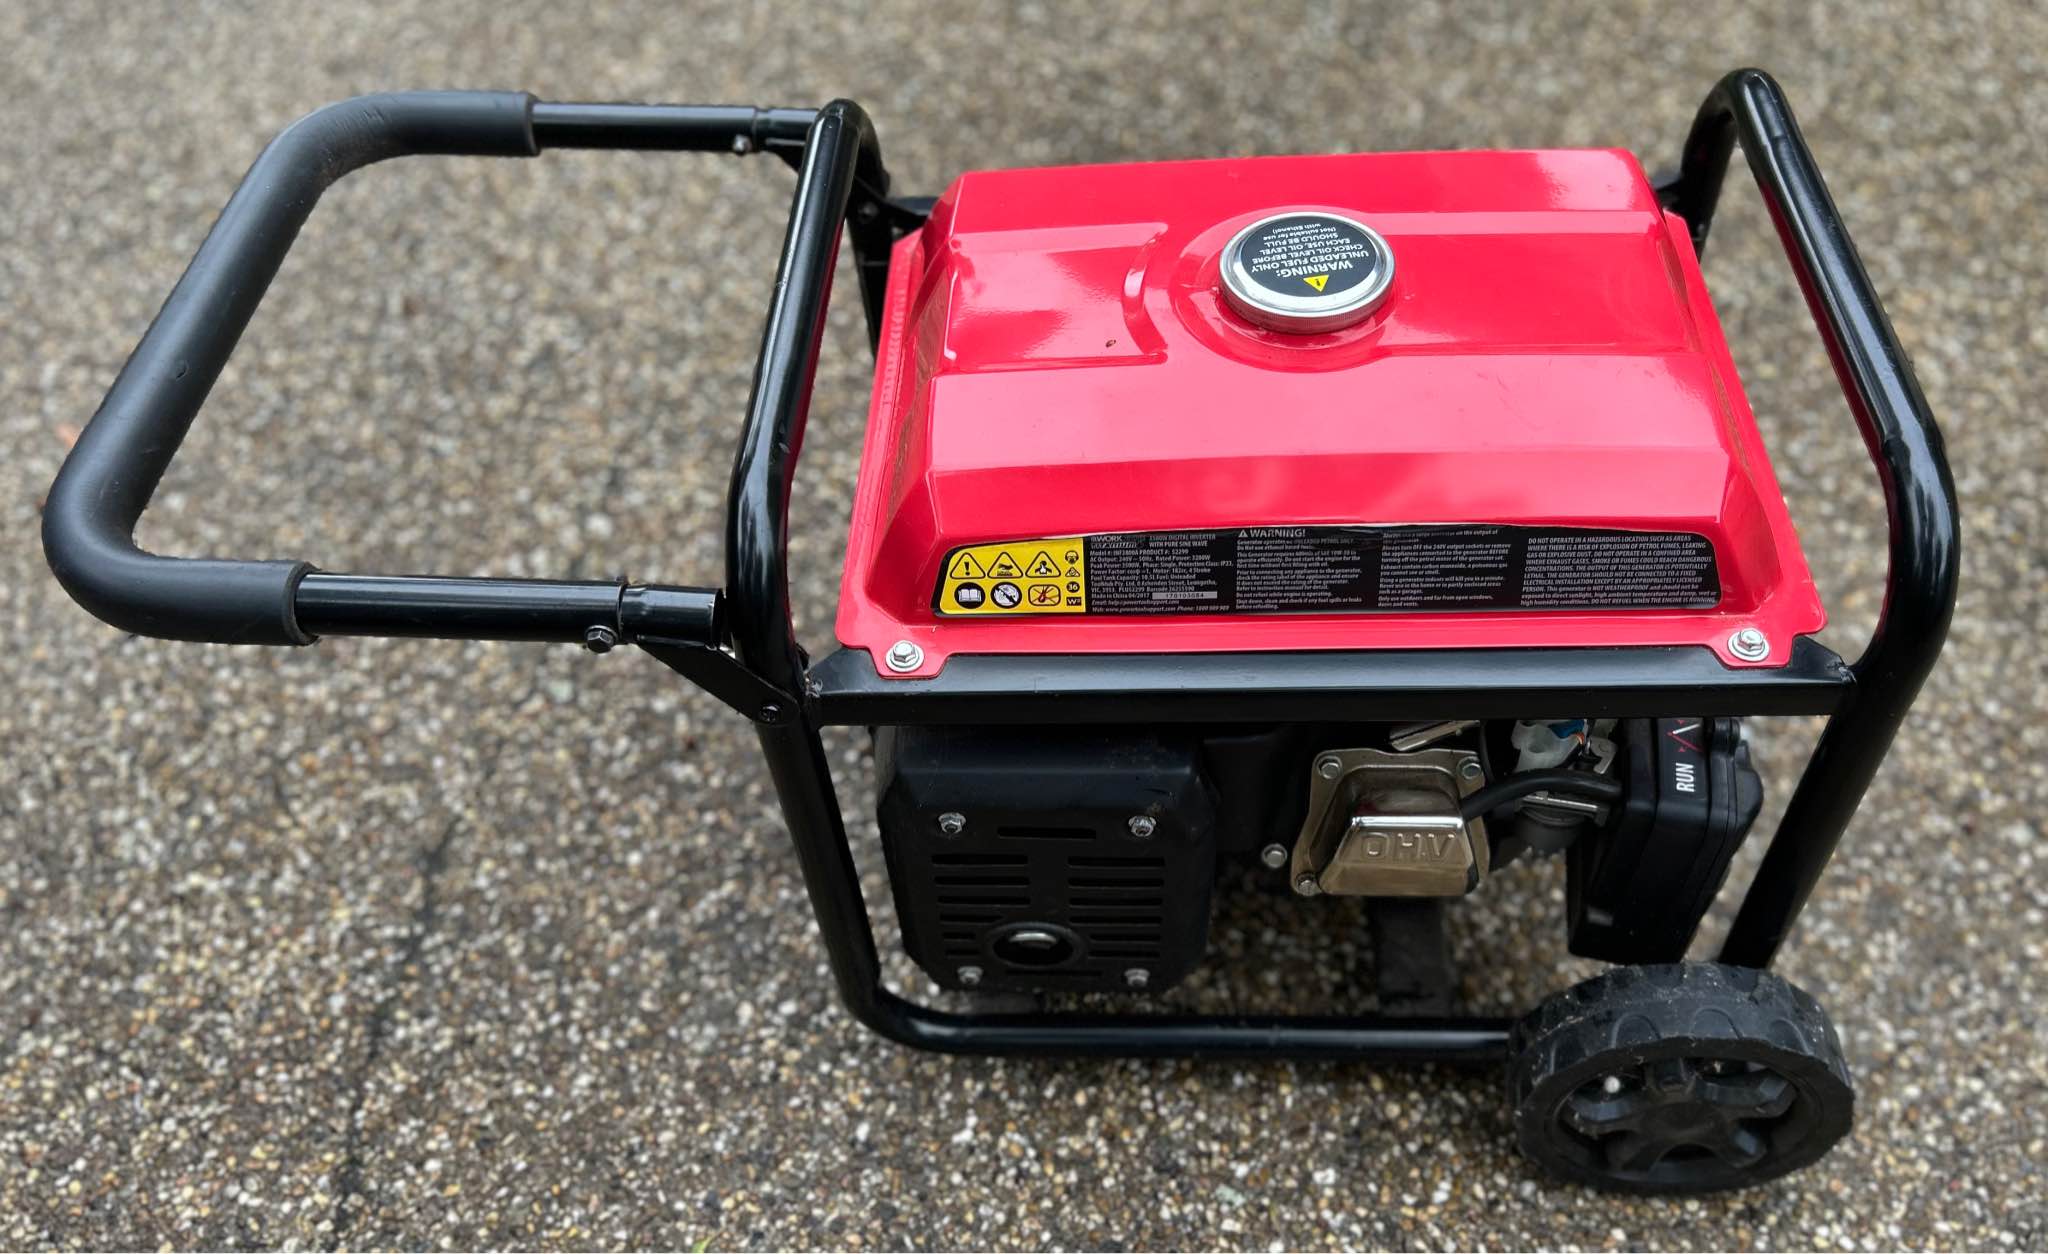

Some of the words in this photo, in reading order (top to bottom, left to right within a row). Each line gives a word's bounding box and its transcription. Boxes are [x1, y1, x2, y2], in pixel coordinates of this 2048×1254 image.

[1301, 232, 1339, 242] SHOULD
[1264, 239, 1287, 248] FULL
[1332, 243, 1363, 252] CHECK
[1259, 247, 1289, 255] LEVEL
[1286, 249, 1316, 259] LEVEL
[1252, 254, 1287, 264] BEFORE
[1310, 250, 1369, 263] UNLEADED
[1281, 258, 1309, 267] FUEL
[1251, 263, 1280, 273] ONLY
[1276, 259, 1353, 278] WARNING:
[1249, 528, 1306, 537] WARNING!
[1526, 551, 1538, 559] GAS
[1558, 585, 1586, 593] generator
[1675, 763, 1695, 792] RUN
[1361, 831, 1457, 862] OHV
